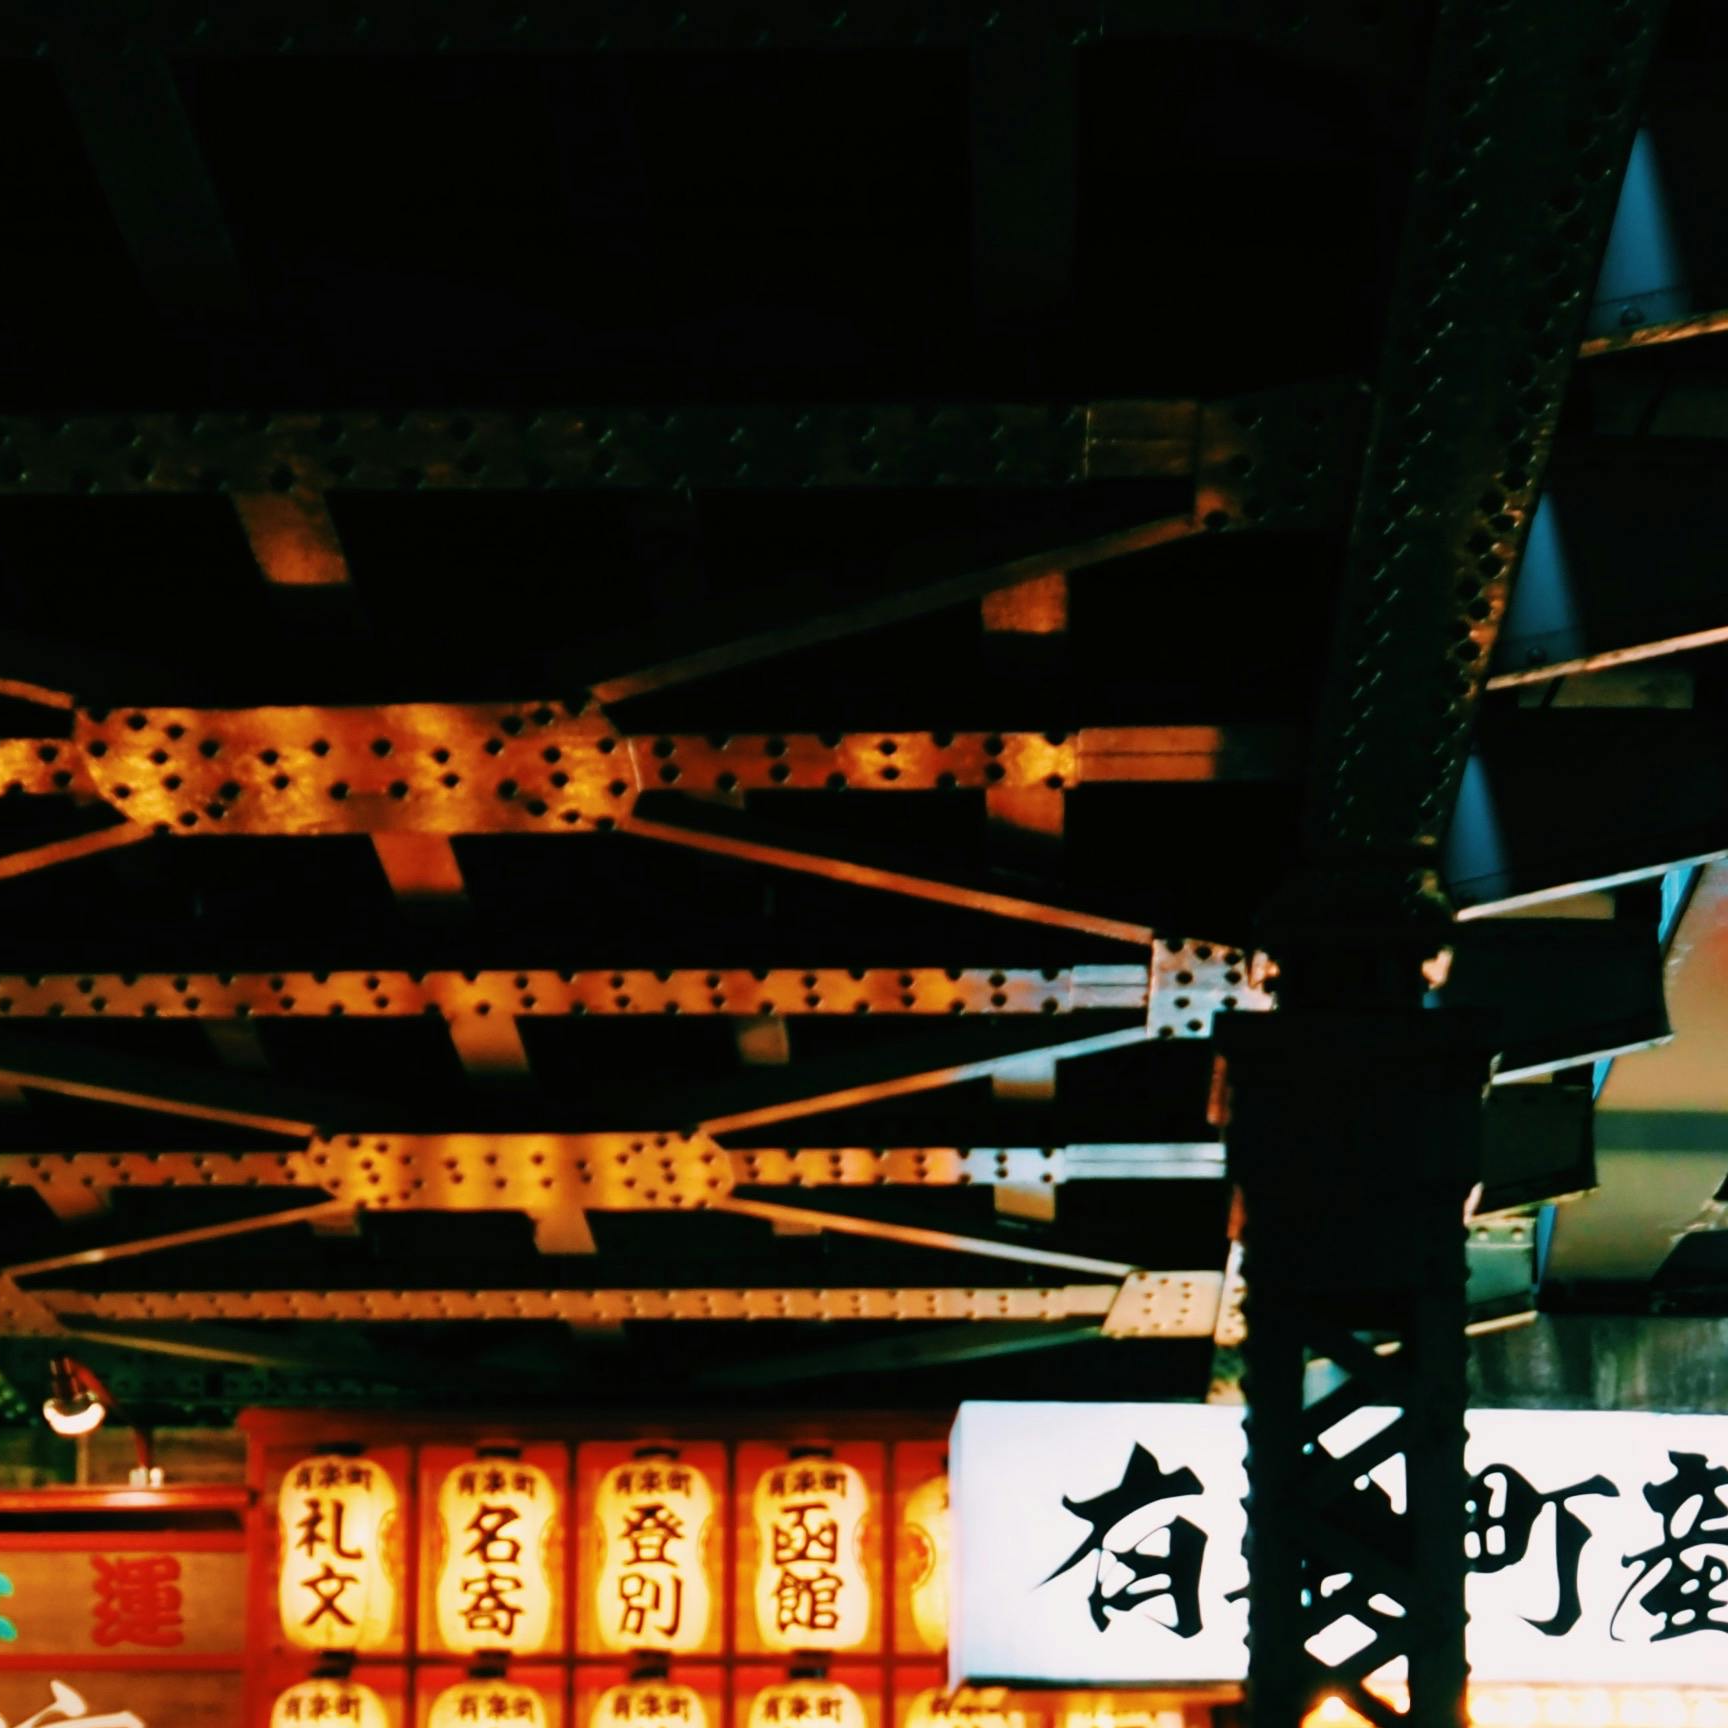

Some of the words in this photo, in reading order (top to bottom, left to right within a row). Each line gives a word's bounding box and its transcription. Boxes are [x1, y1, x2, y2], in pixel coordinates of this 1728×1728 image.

[89, 1554, 185, 1649] 運
[295, 1498, 365, 1627] 礼文
[458, 1502, 525, 1638] 名寄
[619, 1503, 686, 1638] 登別
[771, 1503, 845, 1635] 函館
